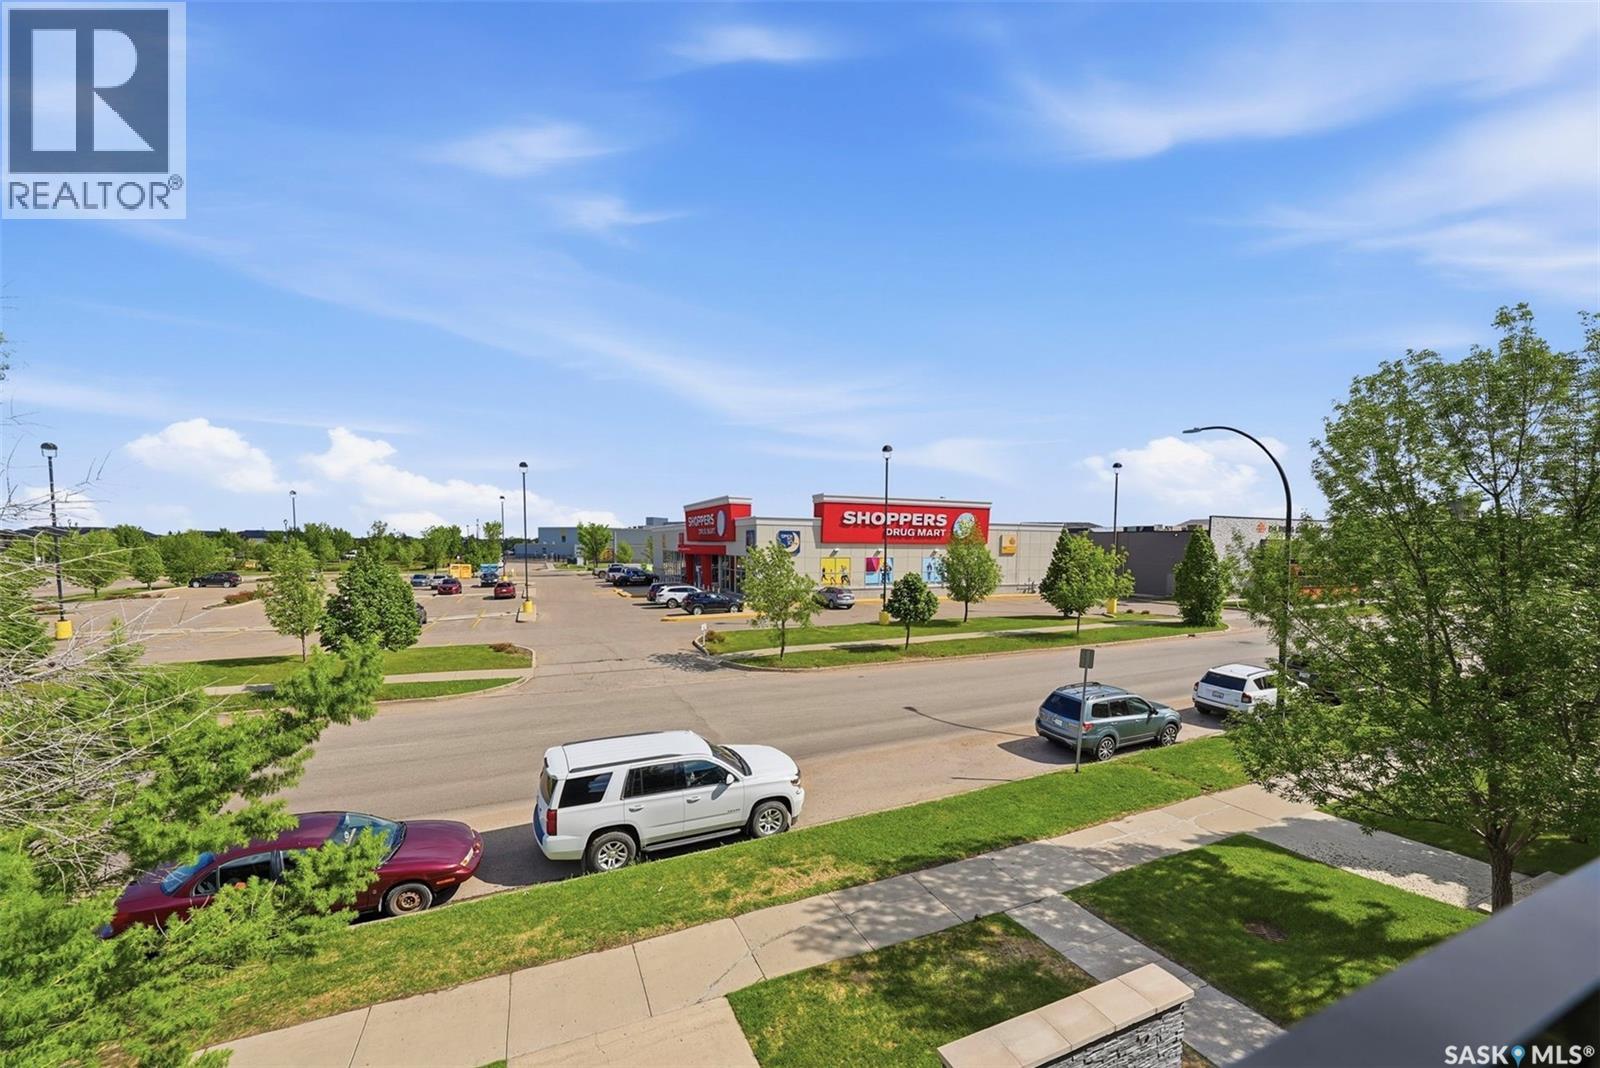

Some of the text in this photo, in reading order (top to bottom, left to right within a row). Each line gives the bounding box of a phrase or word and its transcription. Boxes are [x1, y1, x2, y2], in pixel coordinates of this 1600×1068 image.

[843, 511, 948, 527] SHOPPERS
[886, 528, 947, 537] DRUG MART
